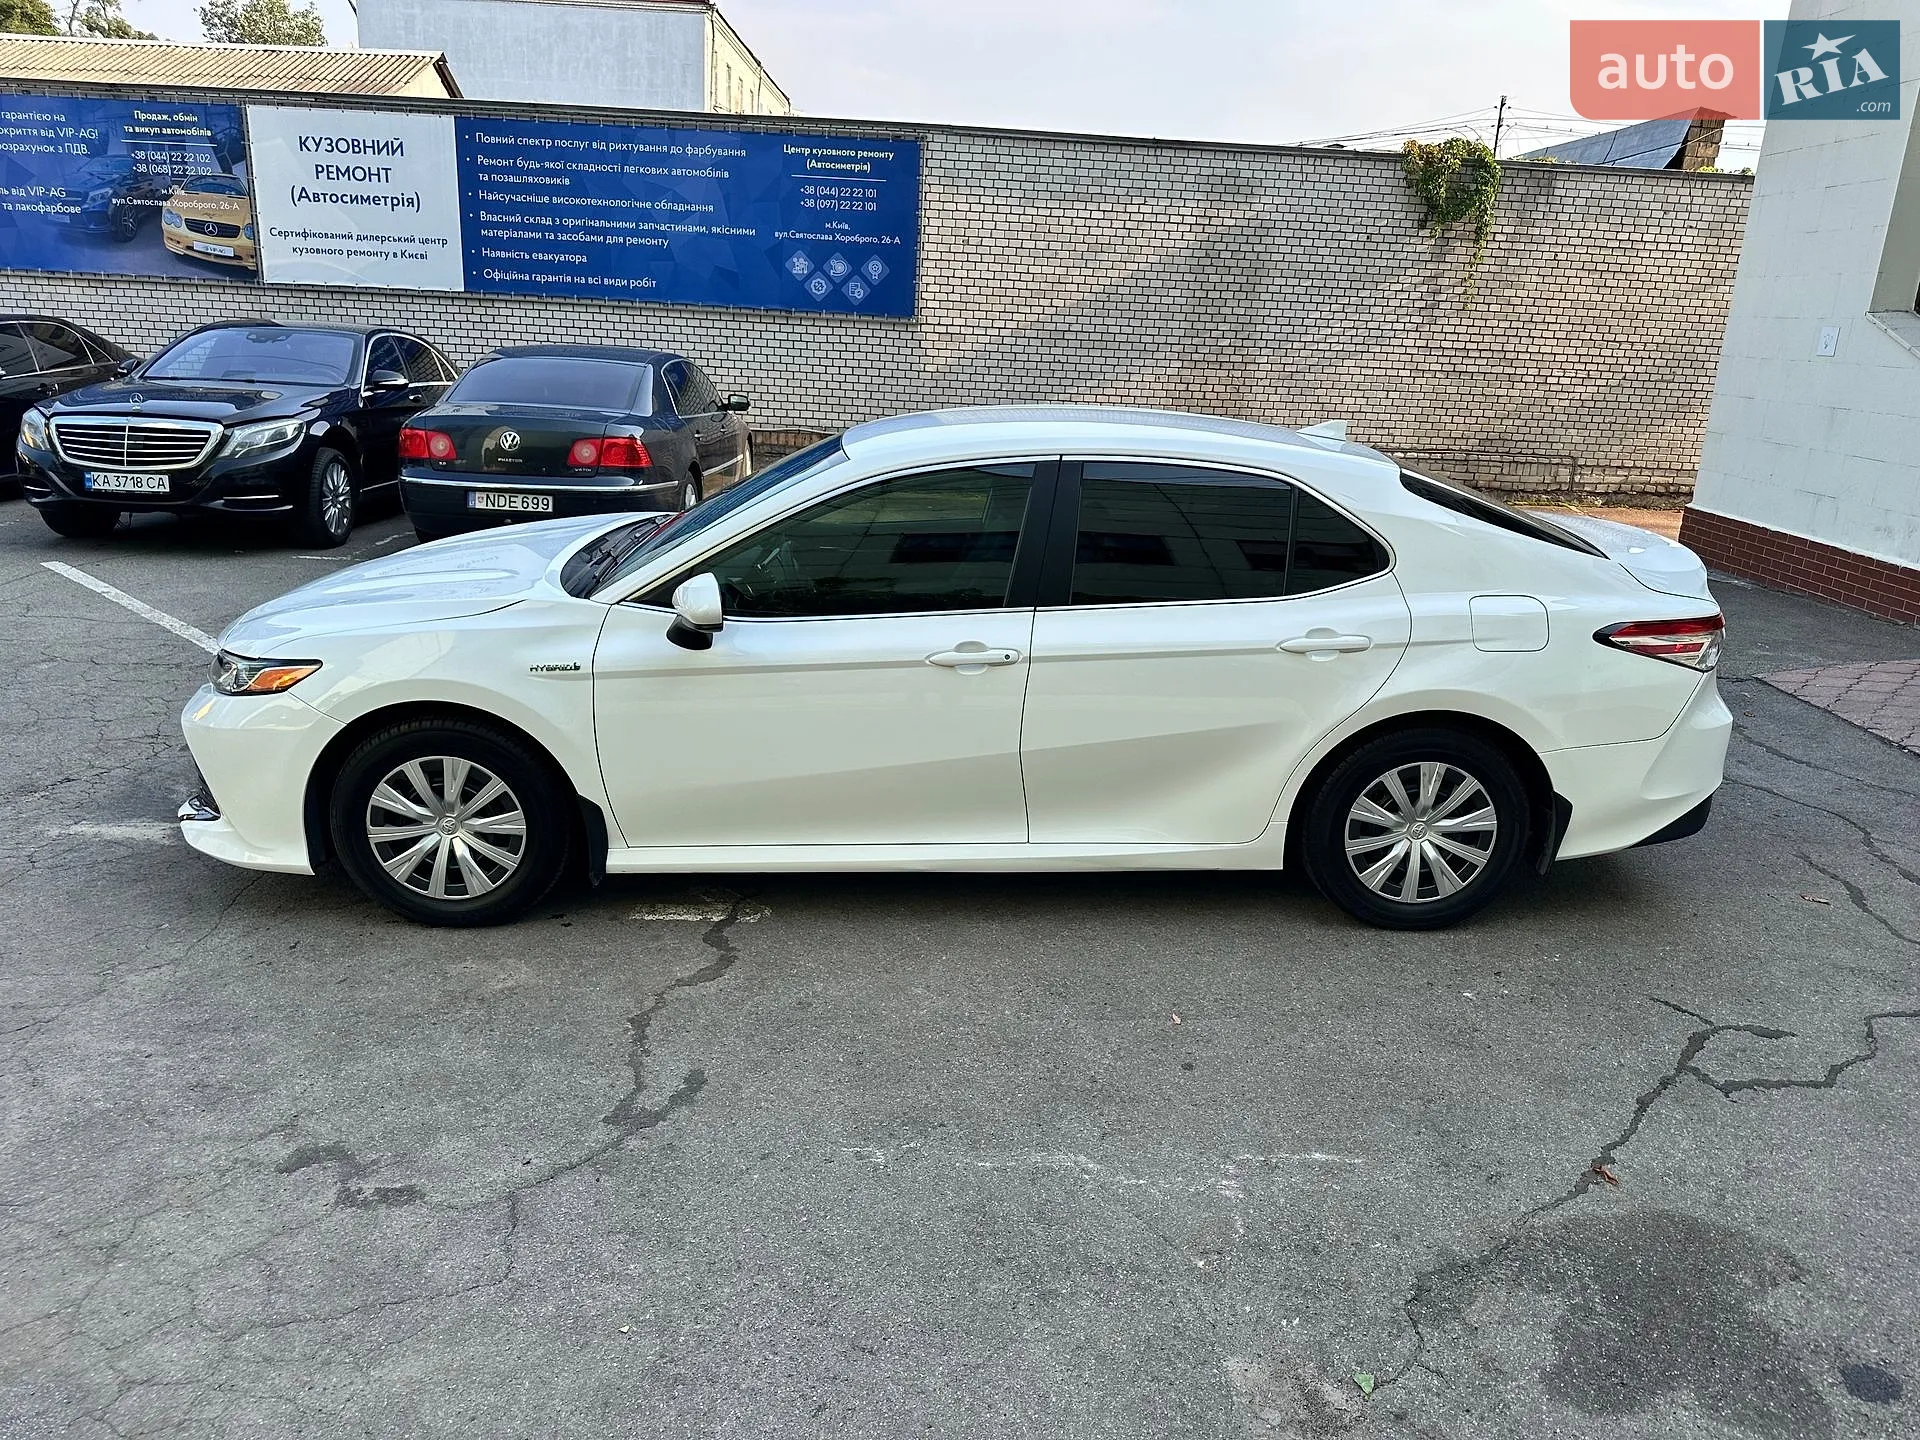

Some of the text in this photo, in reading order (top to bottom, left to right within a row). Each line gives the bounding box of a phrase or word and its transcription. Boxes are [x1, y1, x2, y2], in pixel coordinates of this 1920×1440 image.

[1, 111, 66, 122] гарантією на
[134, 110, 198, 122] Продаж, обмін
[40, 127, 55, 138] від
[56, 127, 99, 139] VIP-AG!
[124, 125, 212, 137] та викуп автомобілів
[0, 143, 91, 155] озрахунок з ПДВ.
[298, 135, 404, 157] КУЗОВНИЙ
[475, 132, 746, 157] Повний спектр послуг від рихтування до фарбування
[783, 144, 894, 160] Центр кузовного ремонту
[131, 150, 211, 163] +38 (044) 22 22 102
[133, 164, 212, 176] +38 (068) 22 22 102
[314, 164, 392, 183] РЕМОНТ
[477, 155, 730, 178] Ремонт будь-якої складності легкових автомобілів
[806, 159, 871, 173] (Автосиметрія)
[478, 173, 570, 185] та позашляховиків
[11, 187, 26, 197] від
[28, 186, 66, 198] VIP-AG
[290, 184, 421, 213] (Автосиметрія)
[800, 185, 877, 198] +38 (044) 22 22 101
[16, 201, 81, 214] лакофарбове
[478, 189, 714, 212] Найсучасніше високотехнологічне обладнання
[800, 199, 877, 211] +38 (097) 22 22 101
[480, 211, 522, 223] Власний
[524, 216, 553, 225] склад
[562, 217, 636, 229] оригінальними
[638, 220, 709, 234] запчастинами,
[711, 224, 756, 236] якісними
[269, 227, 448, 248] Сертифікований дилерський центр
[480, 228, 670, 249] матеріалами та засобами для ремонту
[834, 233, 880, 244] Хороброго,
[292, 245, 344, 256] кузовного
[346, 248, 390, 261] ремонту
[400, 249, 428, 260] Києві
[482, 247, 588, 264] Наявність евакуатора
[483, 268, 530, 280] Офіційна
[531, 273, 572, 284] гарантія
[588, 276, 602, 285] всі
[603, 277, 628, 287] види
[629, 276, 657, 289] робіт
[92, 474, 111, 487] KA
[113, 475, 143, 488] 3718
[146, 476, 167, 489] CA
[485, 494, 550, 511] NDE 699
